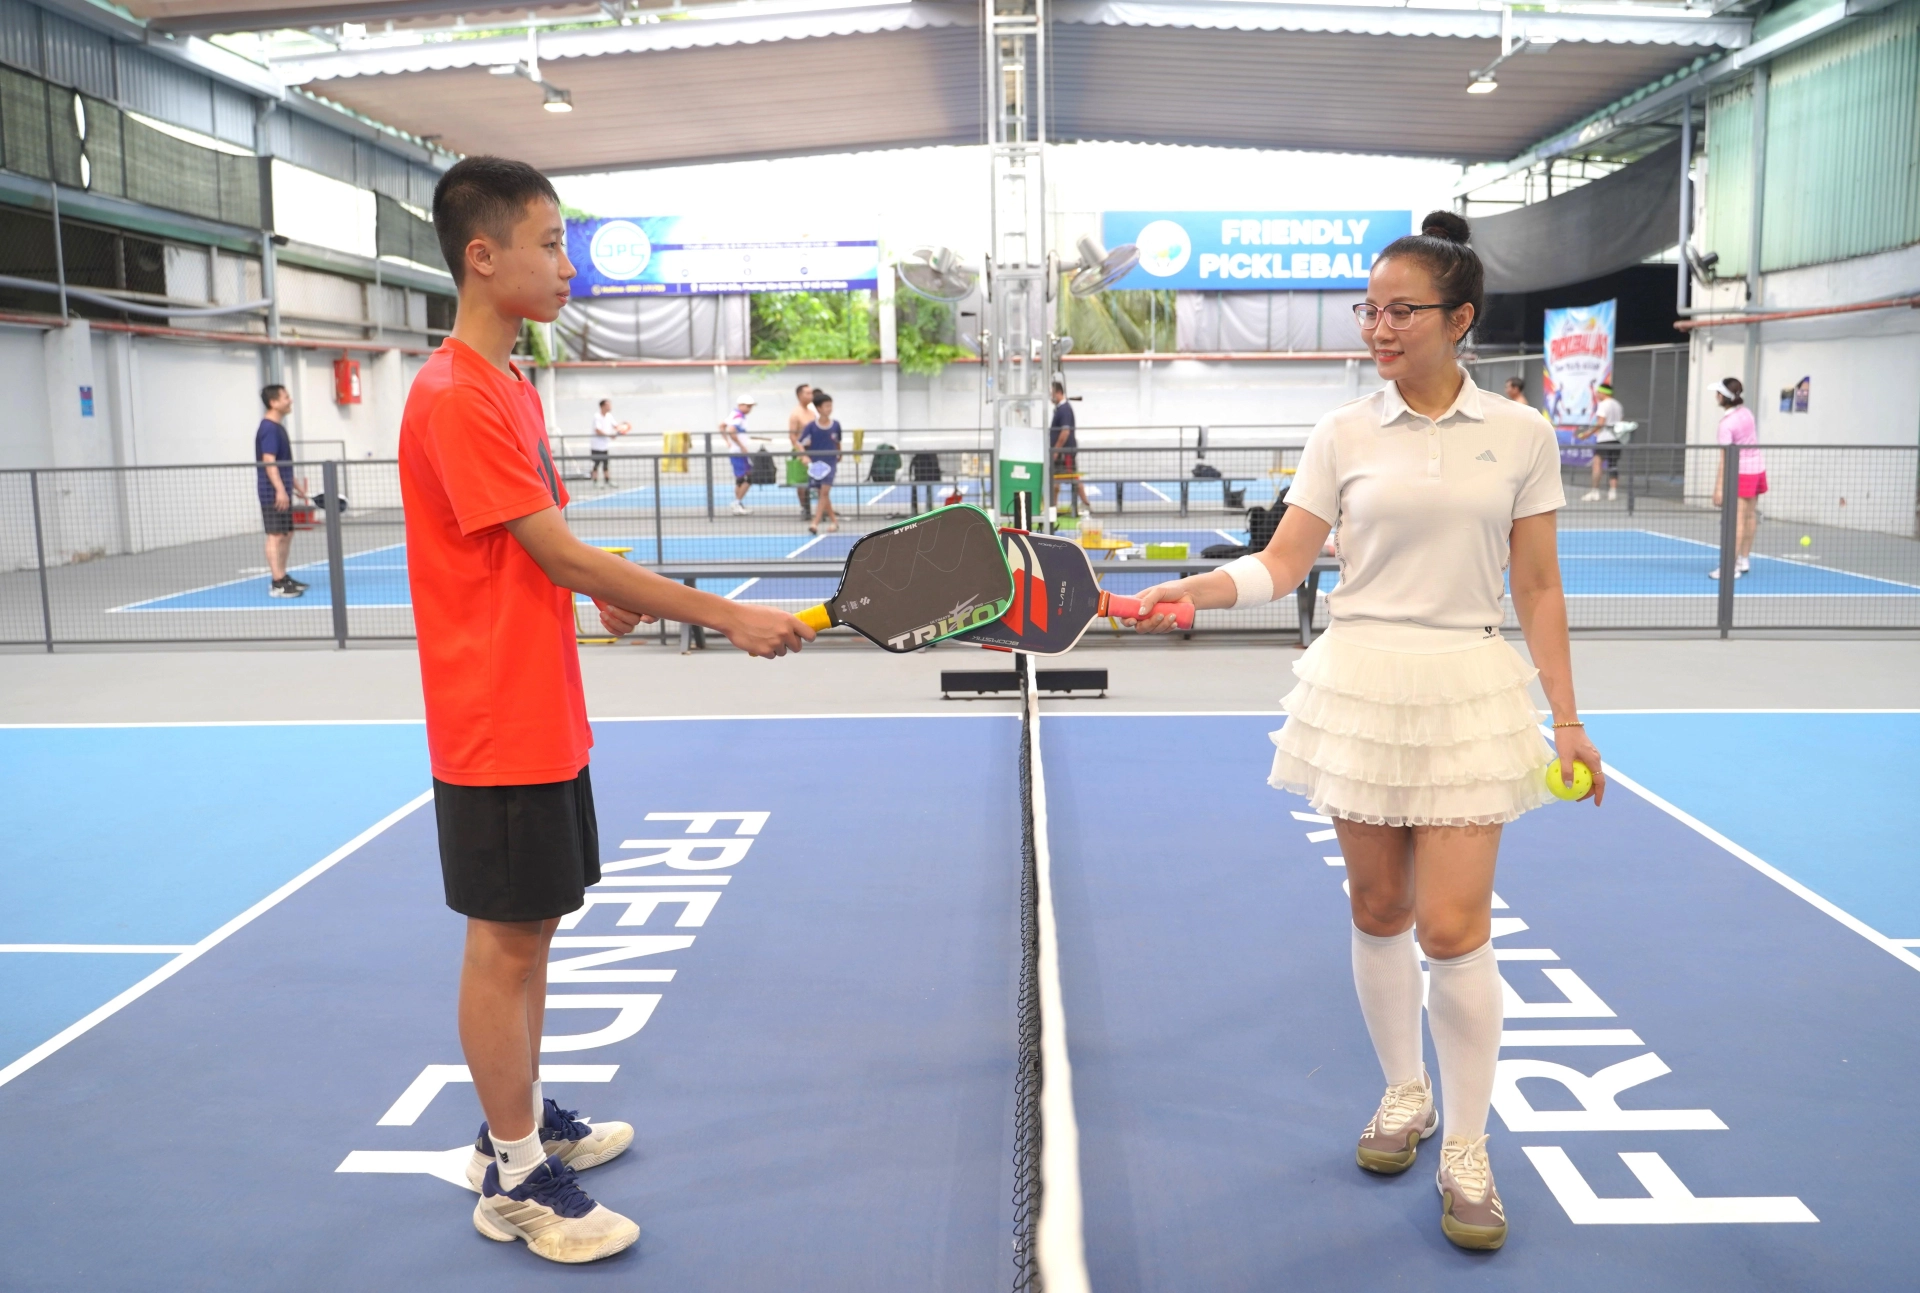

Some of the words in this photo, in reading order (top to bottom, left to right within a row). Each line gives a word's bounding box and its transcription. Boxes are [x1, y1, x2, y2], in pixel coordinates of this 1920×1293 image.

[1221, 219, 1370, 245] FRIENDLY
[1200, 252, 1379, 279] PICKLEBAL
[893, 522, 918, 535] SYPIK
